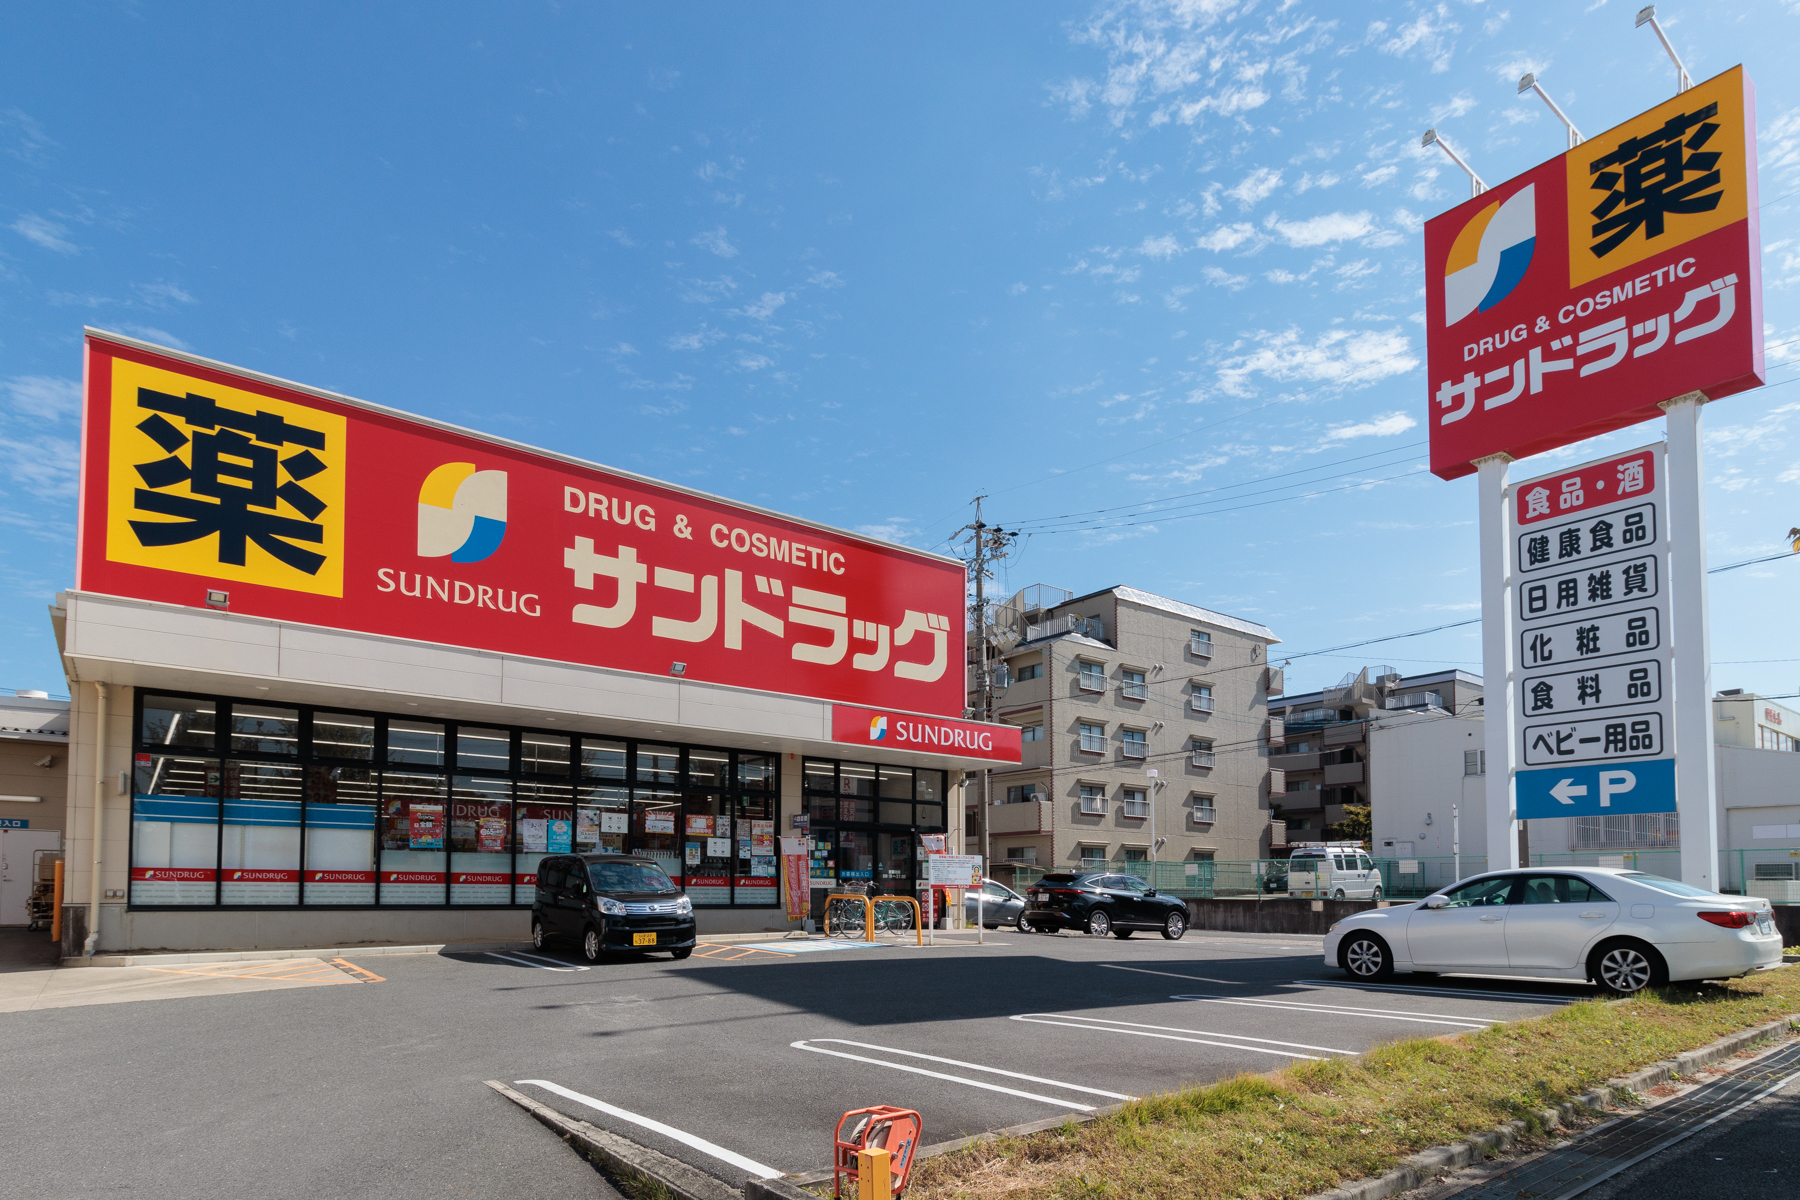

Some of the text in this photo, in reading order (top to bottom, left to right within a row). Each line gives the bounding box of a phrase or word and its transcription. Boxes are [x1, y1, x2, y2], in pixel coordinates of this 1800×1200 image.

[1589, 101, 1725, 259] 薬
[1463, 257, 1696, 362] DRUG & COSMETIC
[1435, 273, 1739, 426] サンドラッグ
[127, 386, 328, 576] 薬
[563, 486, 846, 576] DRUG & COSMETIC
[1526, 511, 1647, 566] 健康食品
[377, 567, 542, 617] SUNDRUG
[563, 535, 951, 683] サンドラッグ
[1528, 562, 1649, 614] 日用雑貨
[1529, 616, 1650, 664] 化粧品
[1531, 667, 1652, 711] 食料品
[895, 720, 993, 752] SUNDRUG
[1532, 720, 1653, 755] ベビー用品
[1599, 769, 1637, 808] P
[155, 870, 205, 879] SUNDRUG
[243, 871, 288, 880] SUNDRUG
[323, 872, 366, 881] SUNDRUG
[398, 874, 437, 882] SUNDRUG
